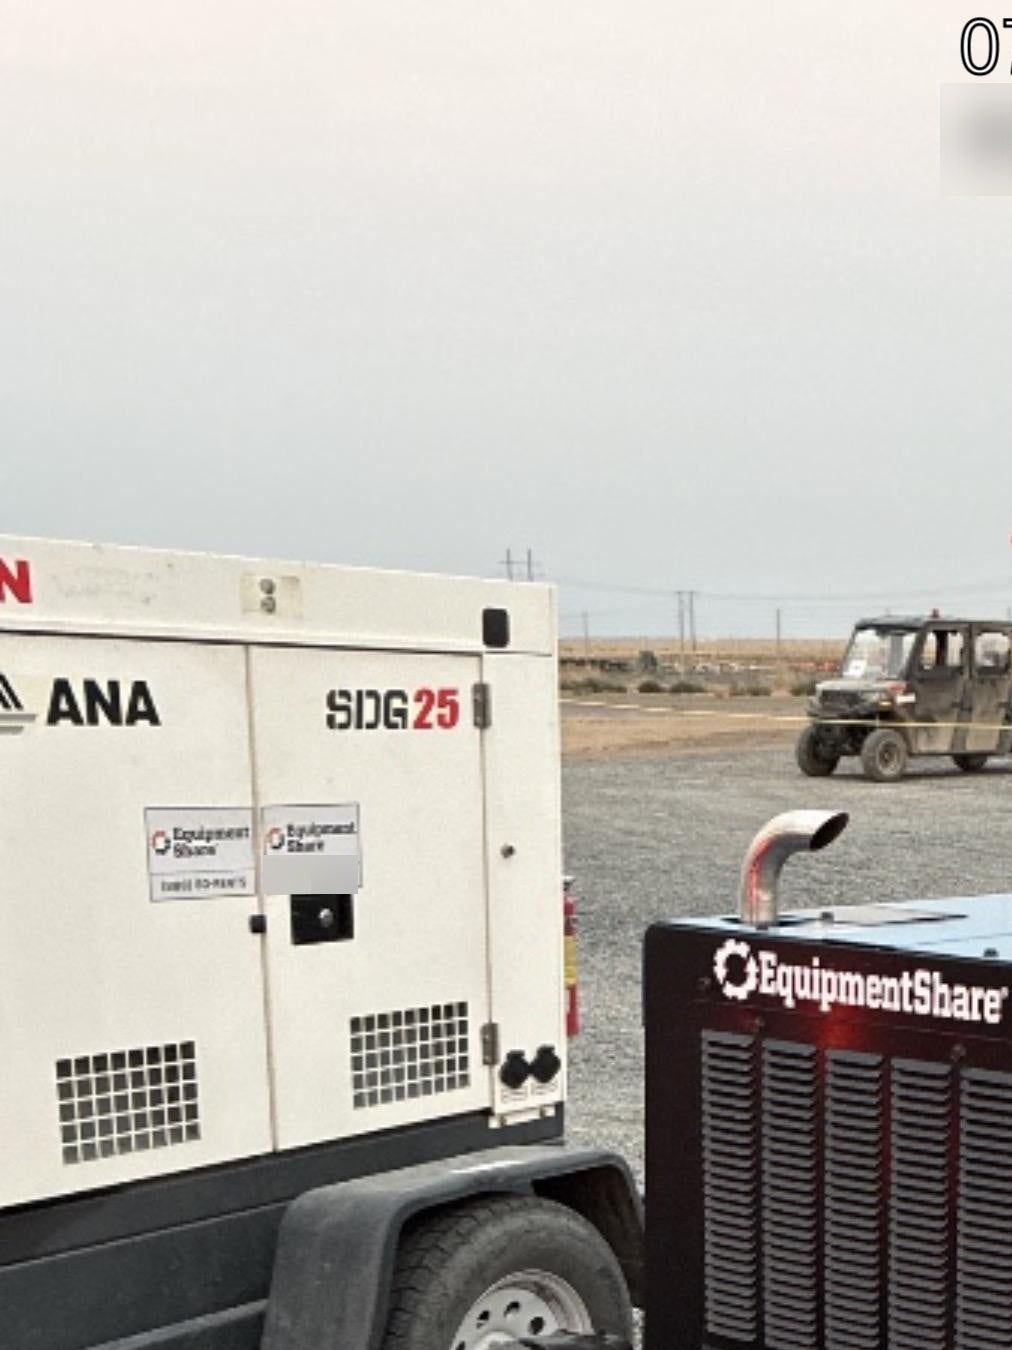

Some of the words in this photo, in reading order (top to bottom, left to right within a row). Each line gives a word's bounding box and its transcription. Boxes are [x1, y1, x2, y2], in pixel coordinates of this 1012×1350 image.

[47, 677, 162, 727] ANA
[325, 688, 460, 730] SDG25
[172, 825, 250, 844] Equipment
[757, 949, 1003, 1025] EquipmentShare
